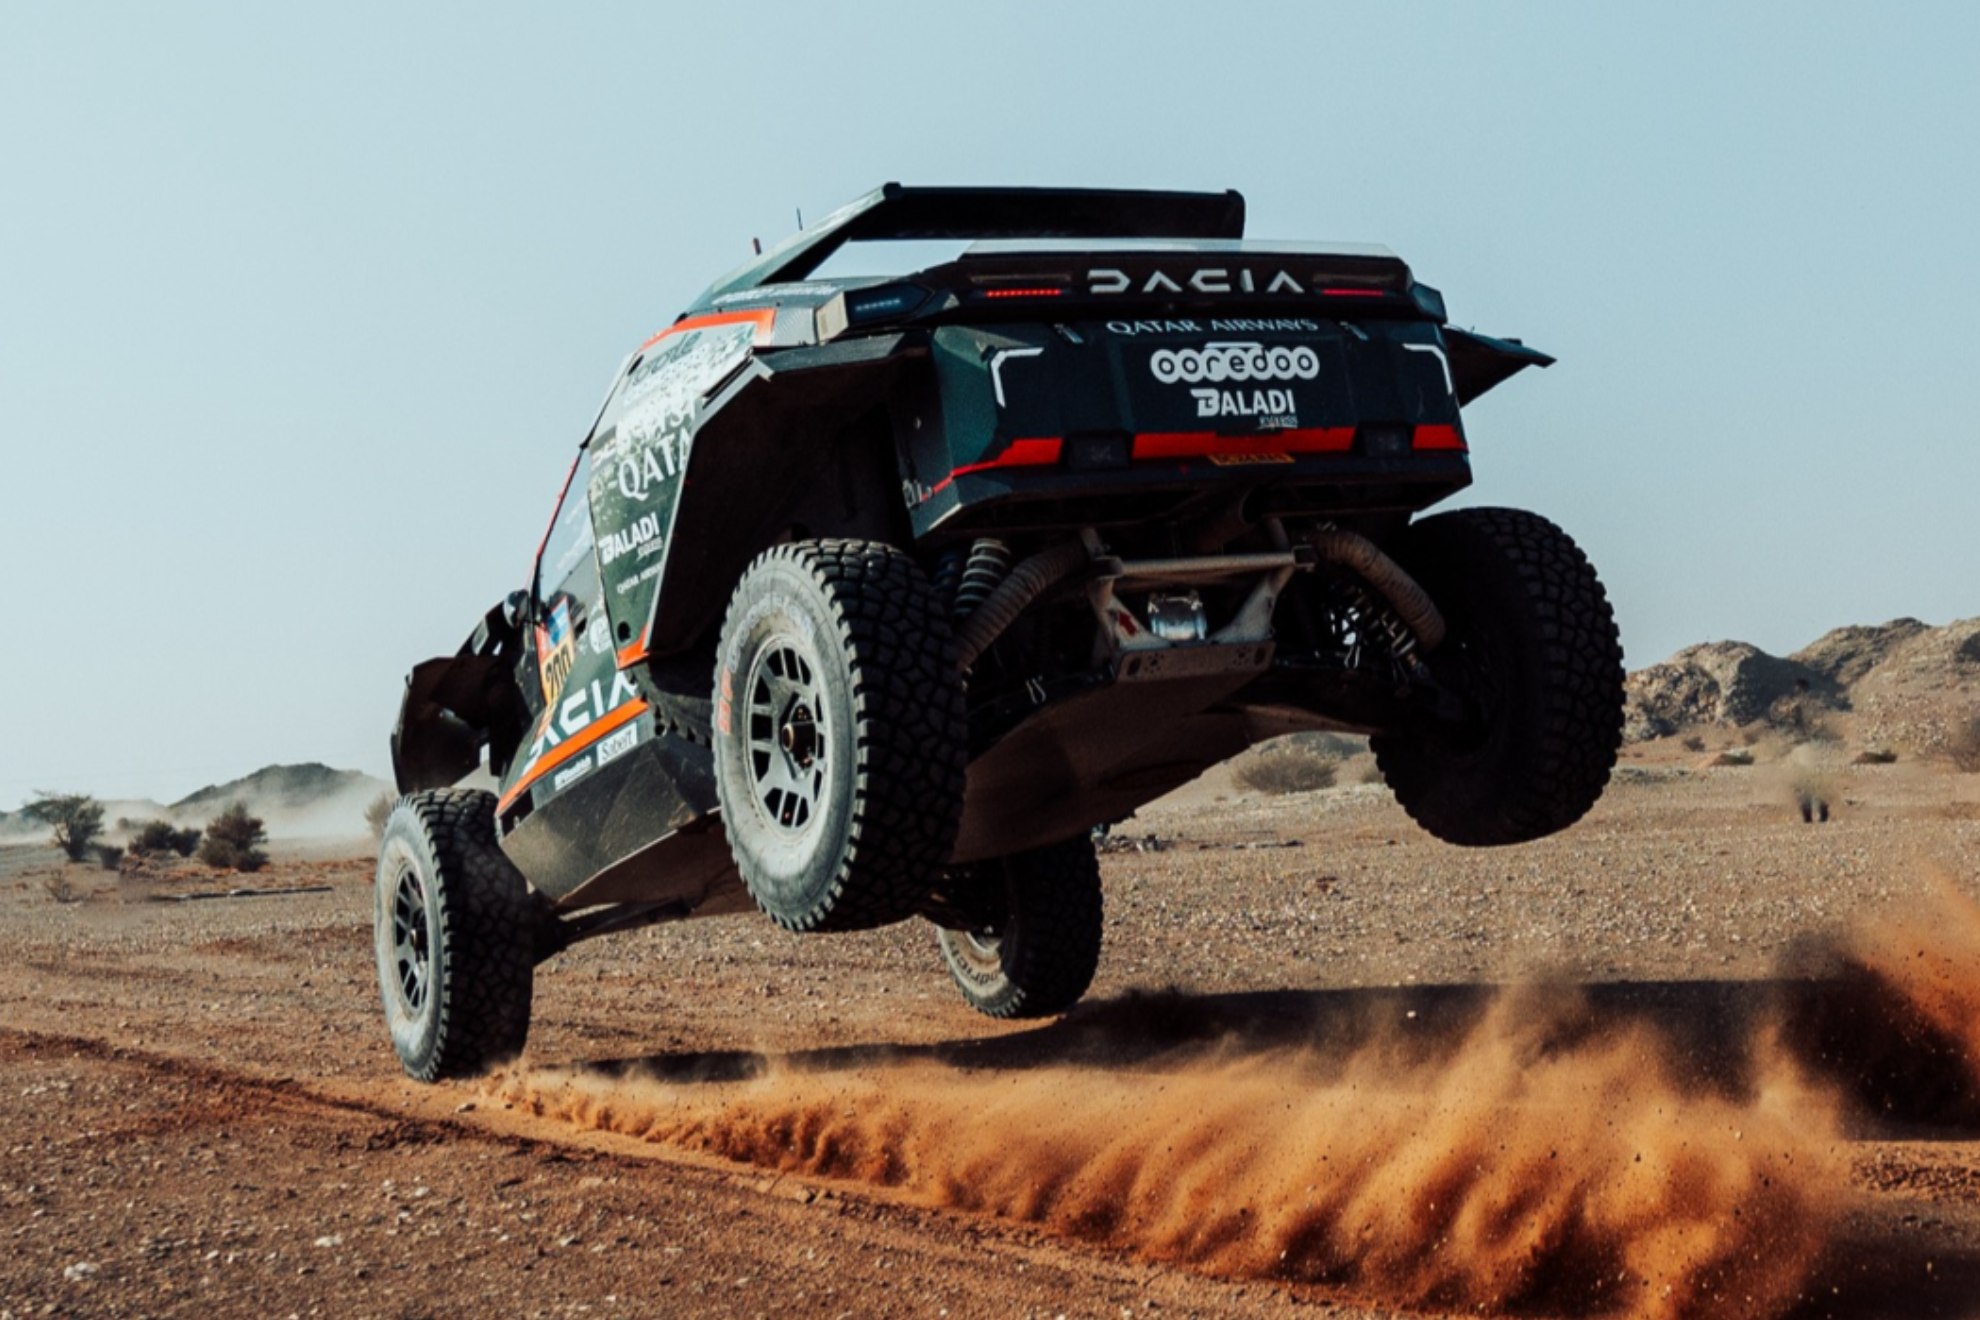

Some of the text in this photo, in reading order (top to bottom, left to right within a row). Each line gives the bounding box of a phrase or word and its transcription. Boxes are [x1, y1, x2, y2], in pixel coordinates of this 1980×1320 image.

[1088, 269, 1305, 295] DACIA
[1106, 318, 1320, 336] QATAR AIRWAYS
[1149, 342, 1321, 384] ooredoo
[1189, 387, 1297, 418] BALADI
[598, 512, 660, 566] BALADI
